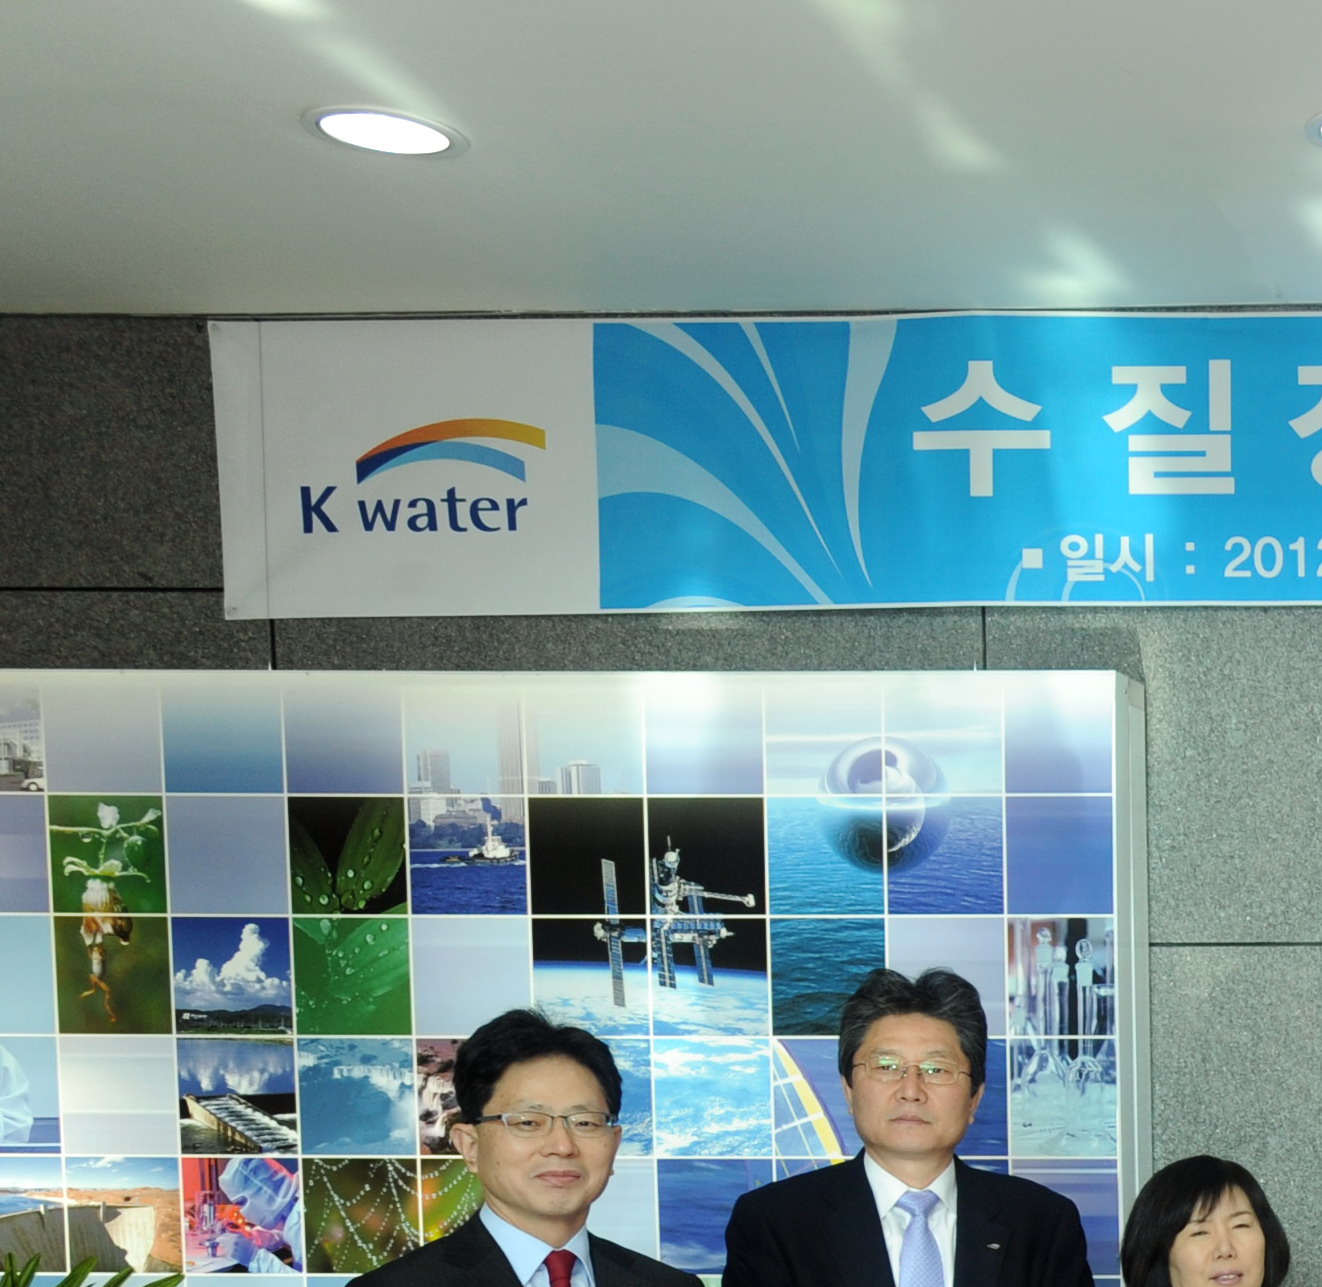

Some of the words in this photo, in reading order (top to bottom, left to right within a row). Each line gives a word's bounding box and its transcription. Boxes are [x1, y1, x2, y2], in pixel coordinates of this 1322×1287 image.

[301, 485, 338, 534] K
[357, 485, 528, 533] water
[1059, 533, 1155, 582] 일시
